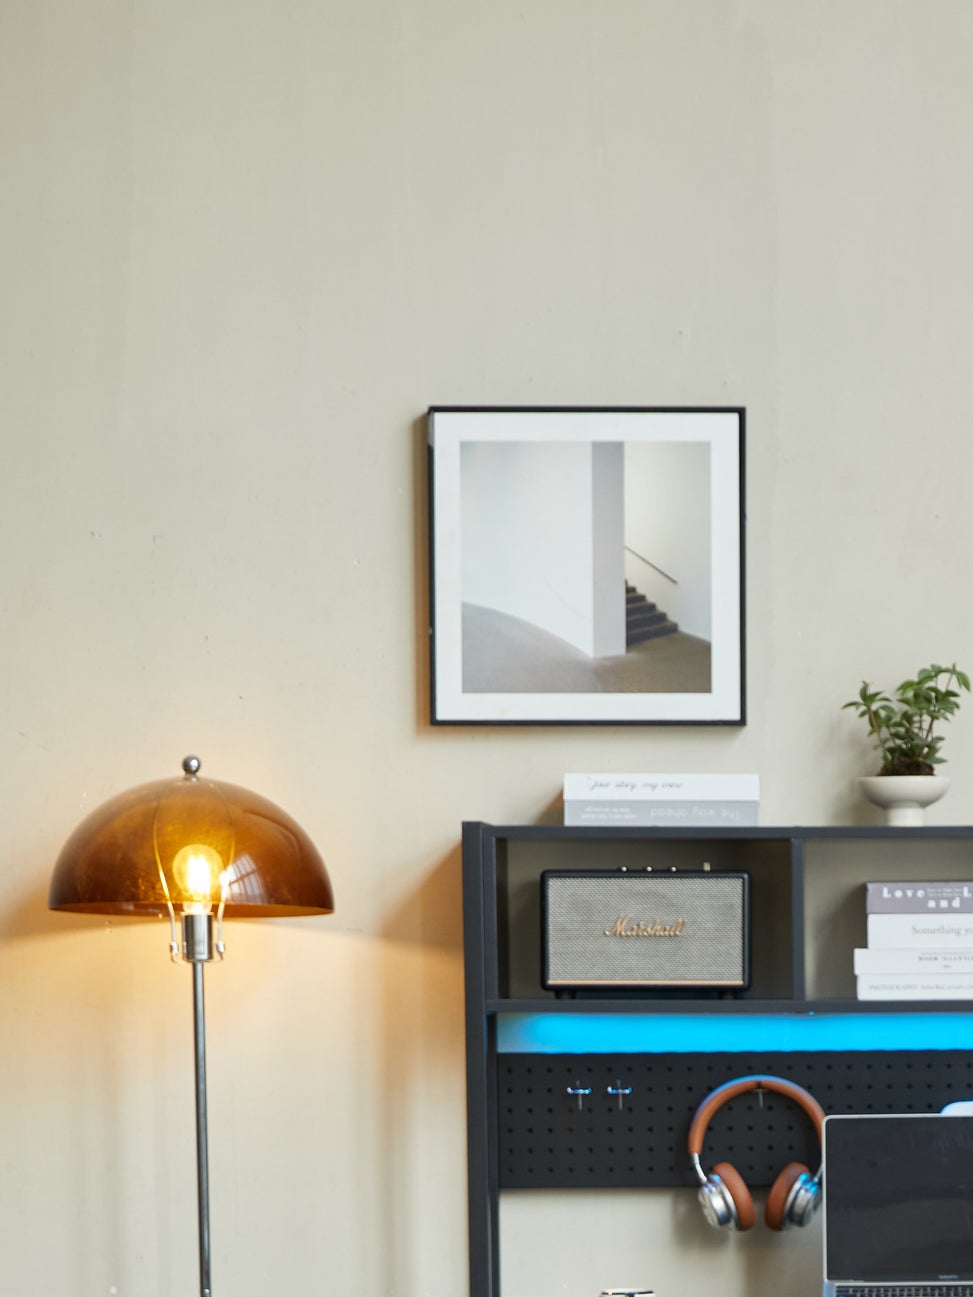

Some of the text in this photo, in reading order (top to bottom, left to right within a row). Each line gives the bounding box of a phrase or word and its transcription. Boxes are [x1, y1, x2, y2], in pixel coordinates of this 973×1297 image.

[882, 886, 925, 898] Love
[927, 897, 961, 908] and
[604, 914, 687, 938] Marshall
[912, 924, 962, 937] Something
